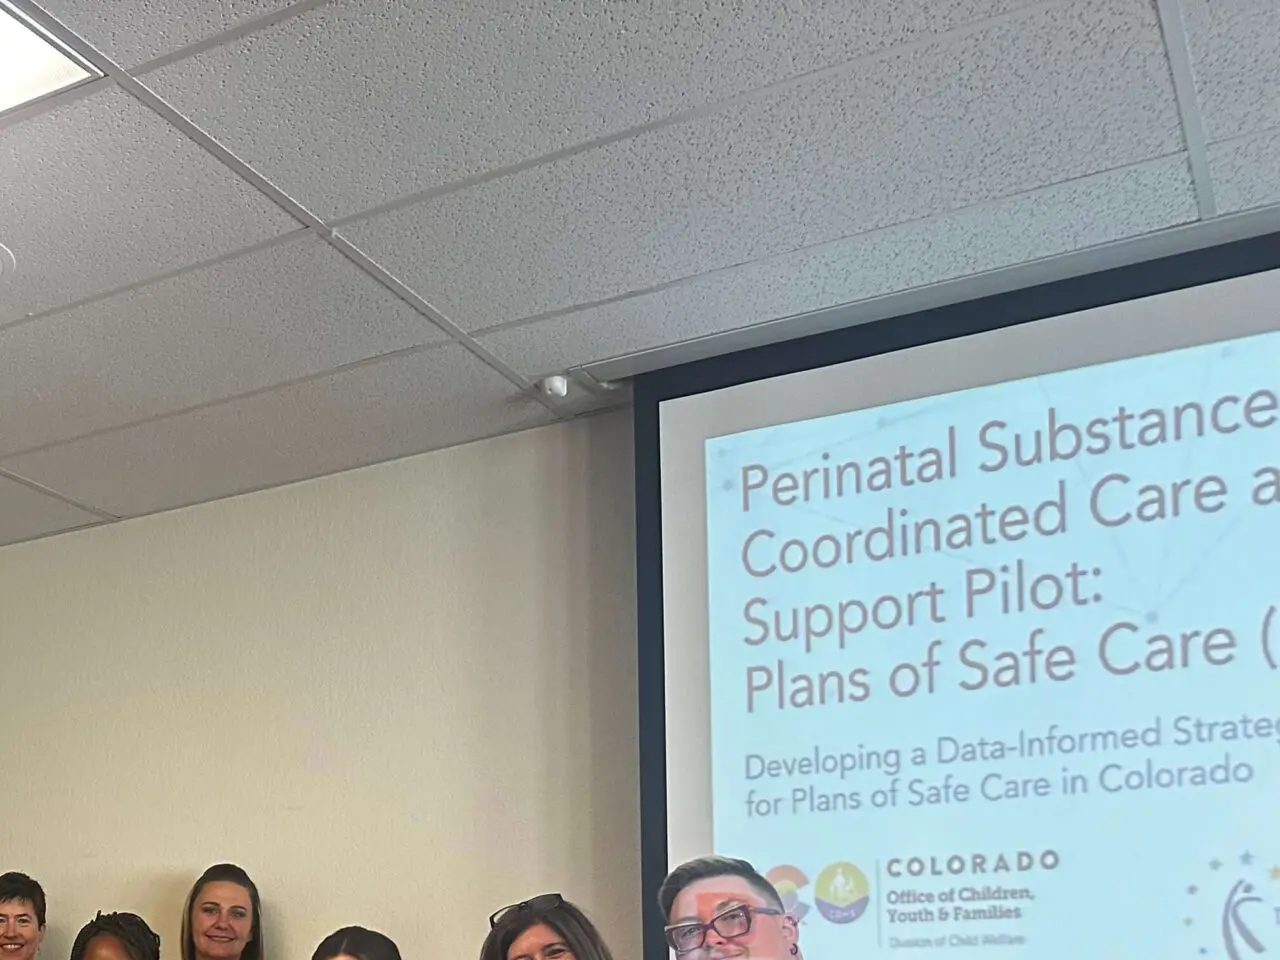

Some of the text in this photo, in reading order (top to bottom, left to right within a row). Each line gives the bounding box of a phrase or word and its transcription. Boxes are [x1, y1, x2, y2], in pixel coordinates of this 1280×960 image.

[740, 389, 1280, 511] Perinatal Substance
[741, 480, 1066, 578] Coordinated
[1089, 472, 1228, 527] Care
[743, 559, 1103, 653] Support Pilot:
[746, 659, 870, 712] Plans
[888, 640, 942, 699] of
[958, 629, 1077, 692] Safe
[1098, 621, 1236, 676] Care
[745, 713, 1280, 782] Developing a Data-Informed Strate
[745, 754, 1254, 818] for Plans of Safe Care in Colorado
[886, 850, 1060, 877] COLORADO
[886, 885, 1035, 905] Office of Children,
[886, 905, 1022, 923] Youth & Families
